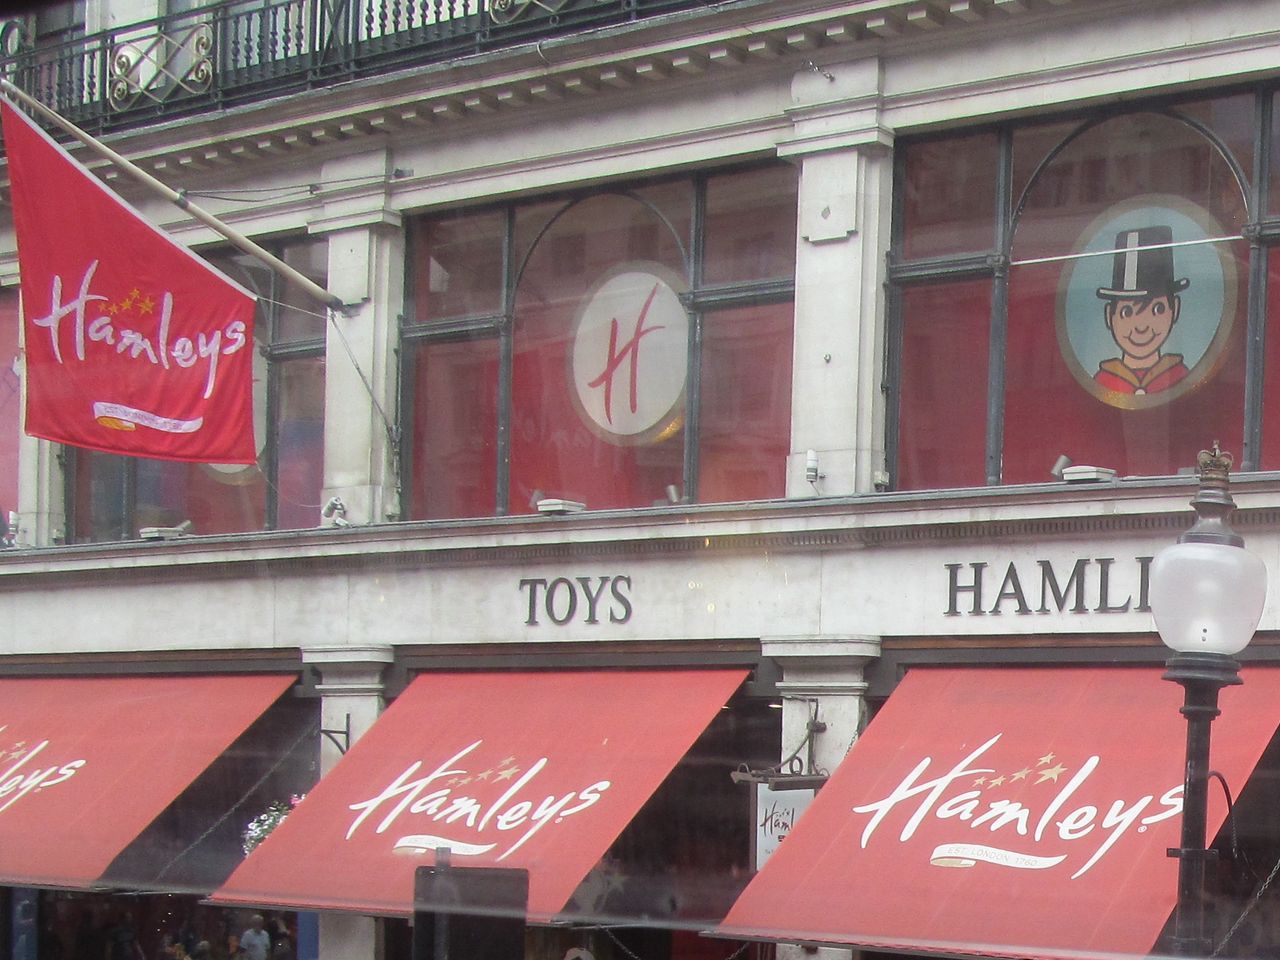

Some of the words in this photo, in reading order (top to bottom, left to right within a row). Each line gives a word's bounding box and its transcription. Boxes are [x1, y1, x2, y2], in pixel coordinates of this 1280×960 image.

[32, 259, 247, 400] Hamleys
[586, 281, 667, 426] H
[518, 574, 633, 626] TOYS
[345, 739, 611, 862] Hamleys
[760, 800, 795, 837] Haml
[852, 732, 1184, 880] Hamleys
[971, 848, 1009, 862] LONDON
